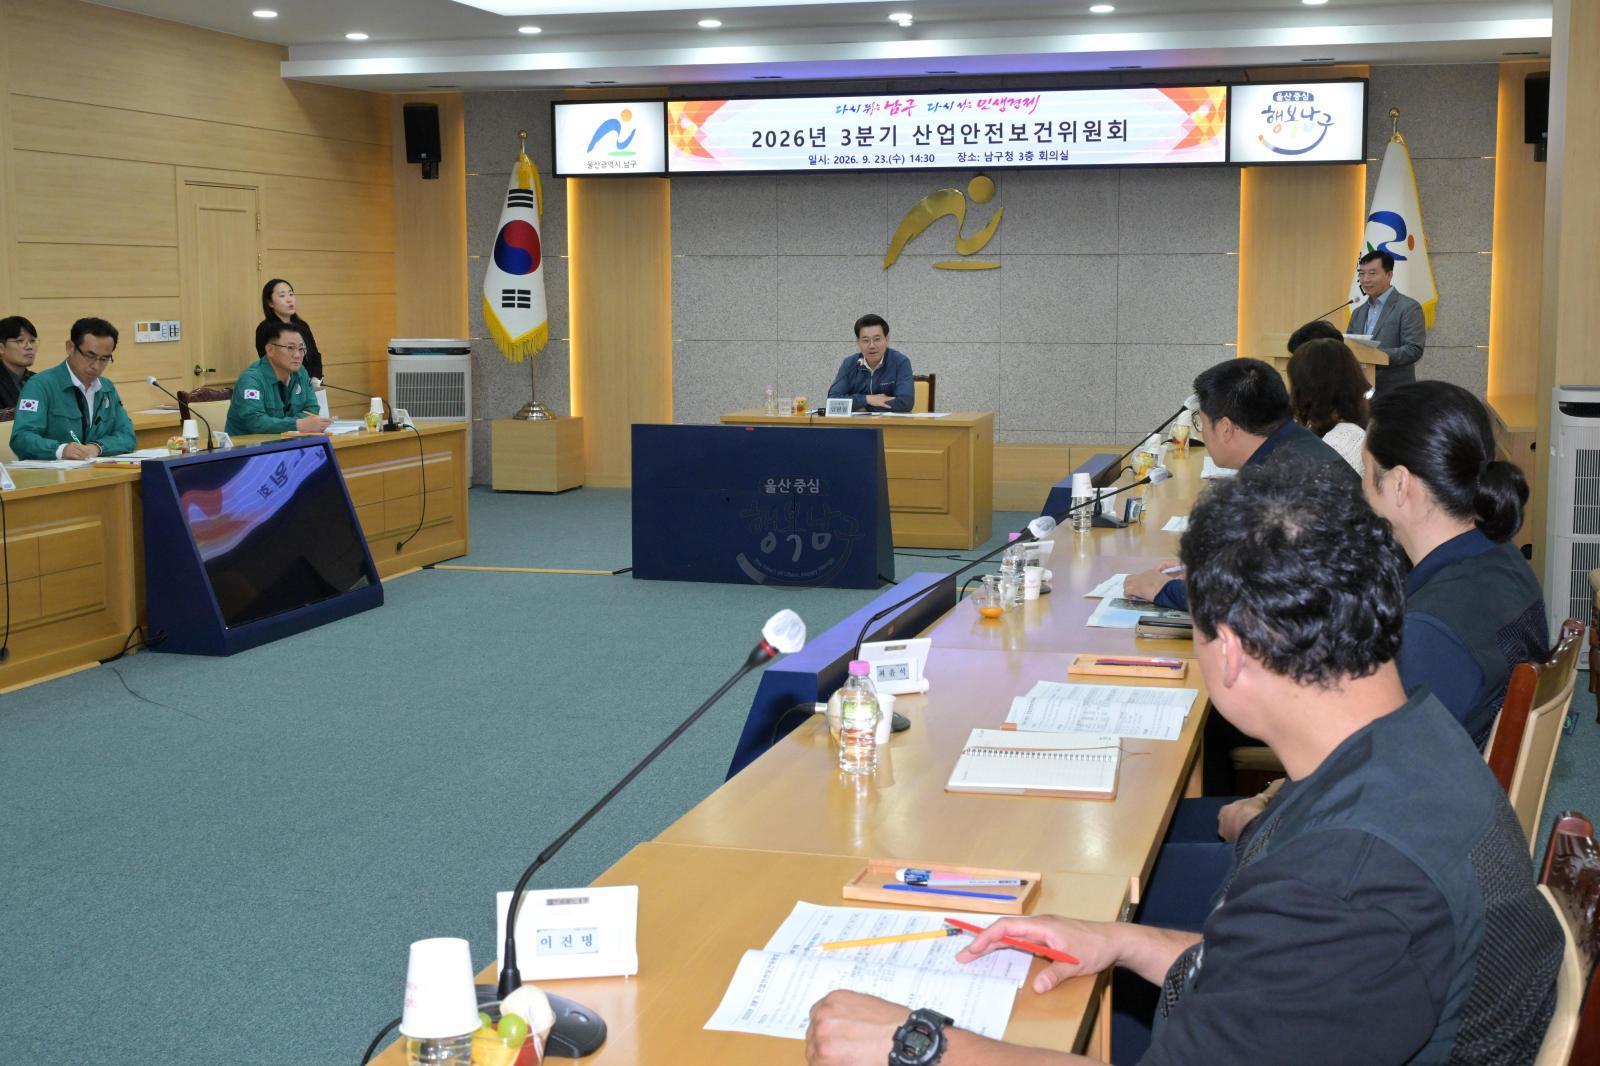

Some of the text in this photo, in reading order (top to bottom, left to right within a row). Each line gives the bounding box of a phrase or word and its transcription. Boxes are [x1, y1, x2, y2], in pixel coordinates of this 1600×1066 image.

[835, 104, 862, 115] 다시
[883, 99, 917, 117] 남구
[927, 101, 955, 113] 다시
[977, 95, 1041, 115] 민생경제
[751, 119, 1129, 148] 2026년 3분기 산업안전보건위원회
[587, 160, 637, 170] 울산광역시 남구
[808, 149, 1070, 166] 일시: 2026. 9. 23.(수) 14:30 장소: 남구청 3층 회의실
